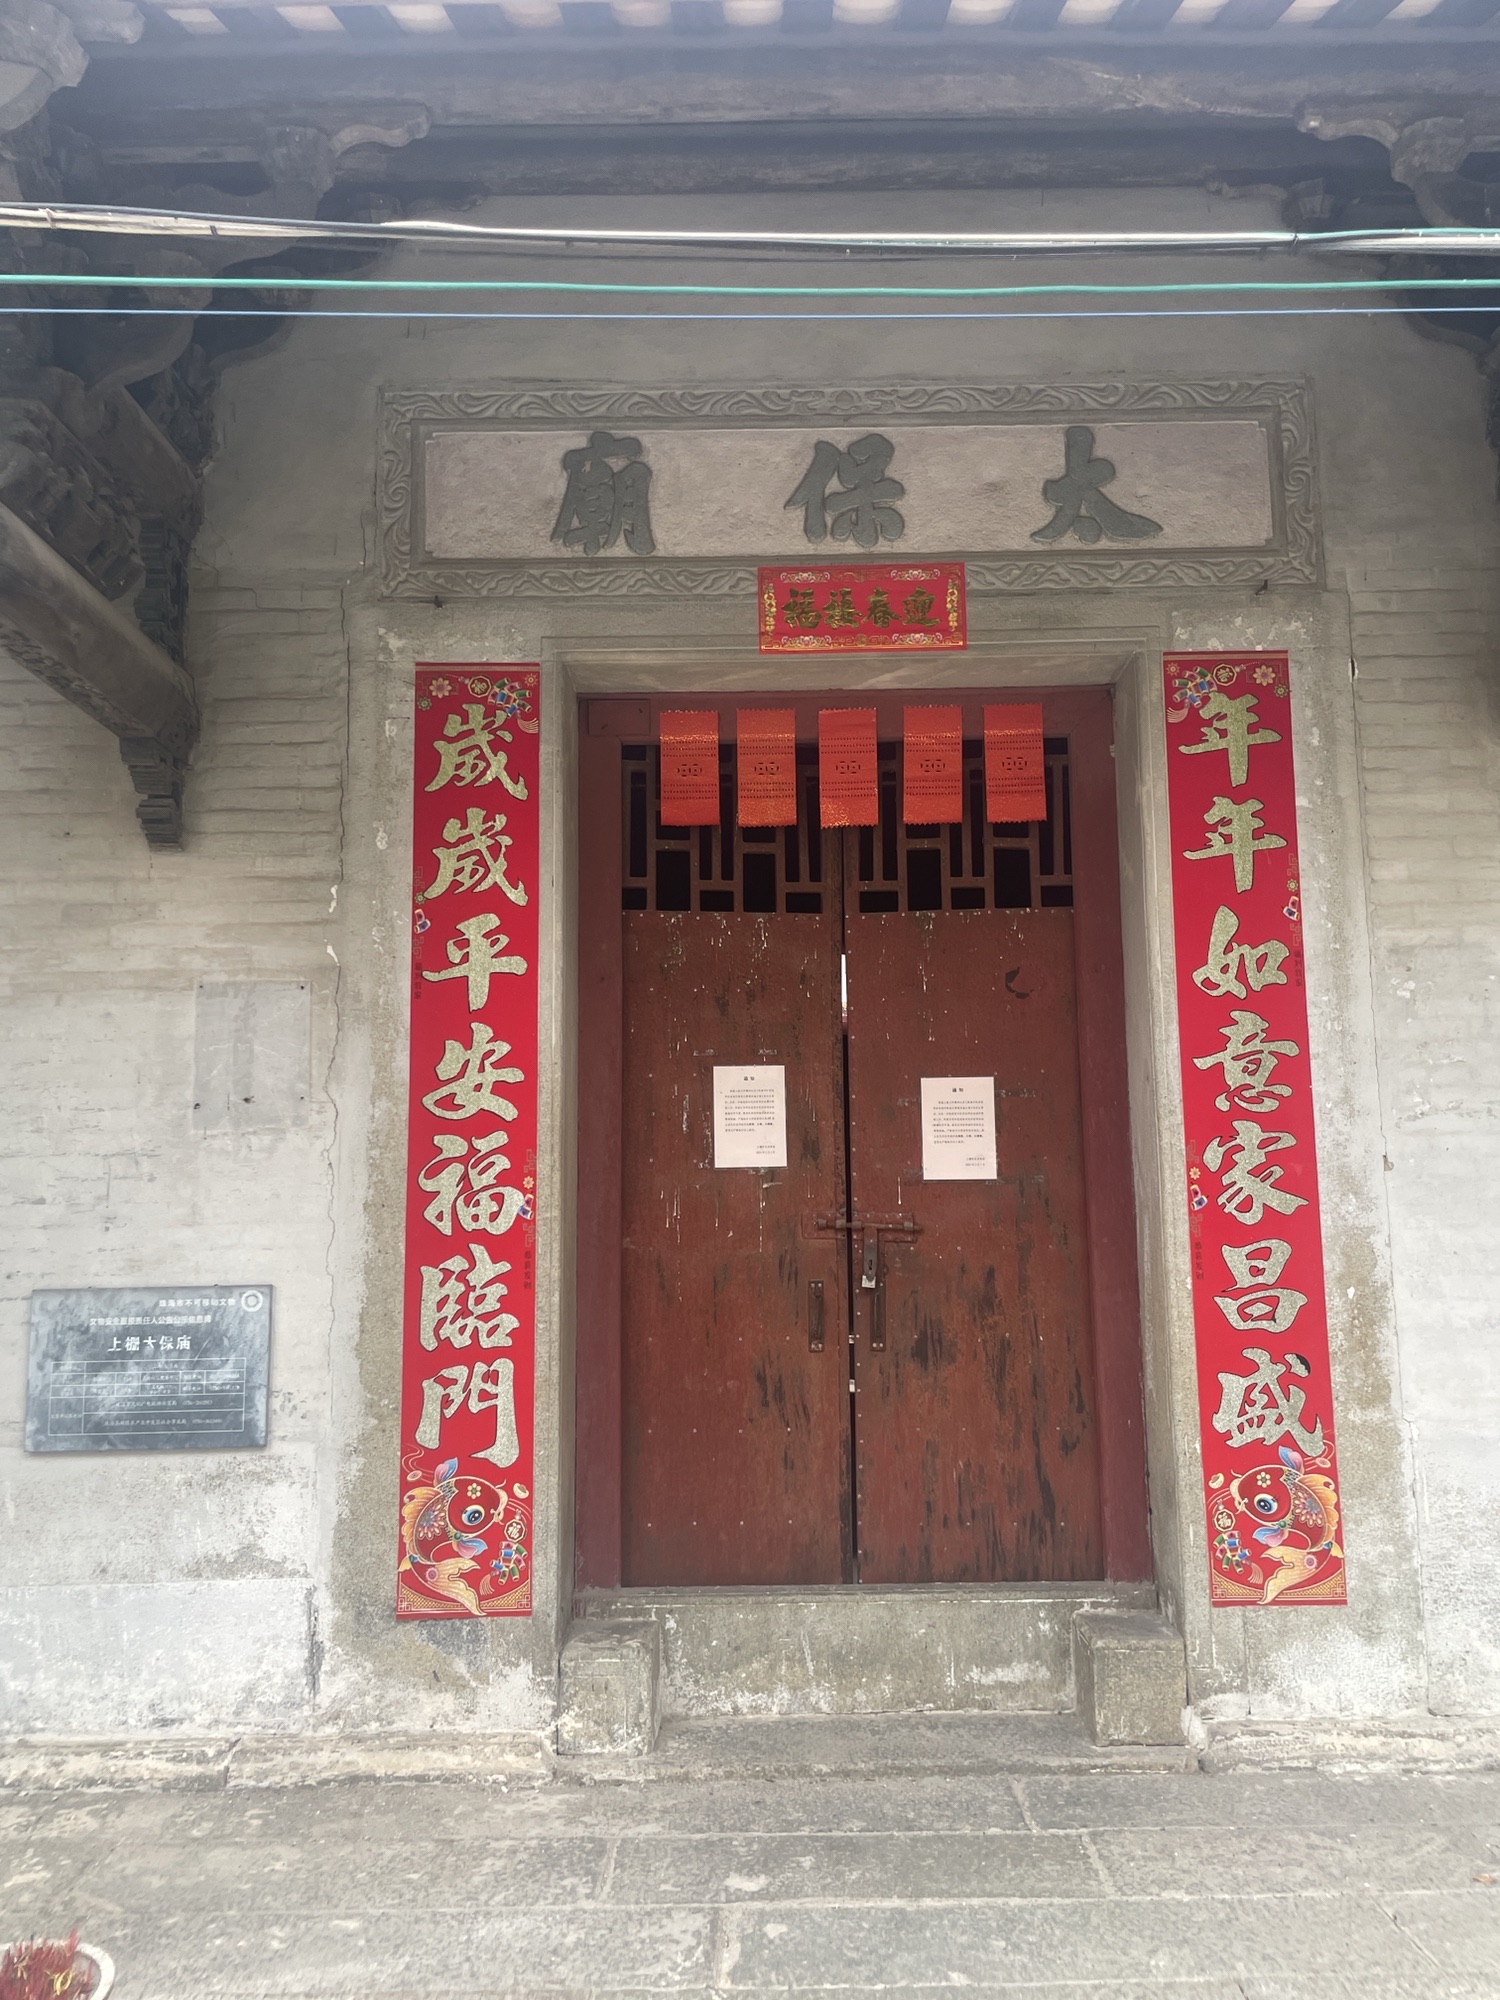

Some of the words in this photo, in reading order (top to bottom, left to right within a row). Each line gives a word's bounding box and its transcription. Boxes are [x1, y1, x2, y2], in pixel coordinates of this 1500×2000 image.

[550, 426, 1163, 556] 太保廟
[781, 585, 943, 631] 迎春接福
[414, 702, 530, 1470] 歲歲平安福臨門
[1177, 690, 1325, 1457] 年年如意家昌盛
